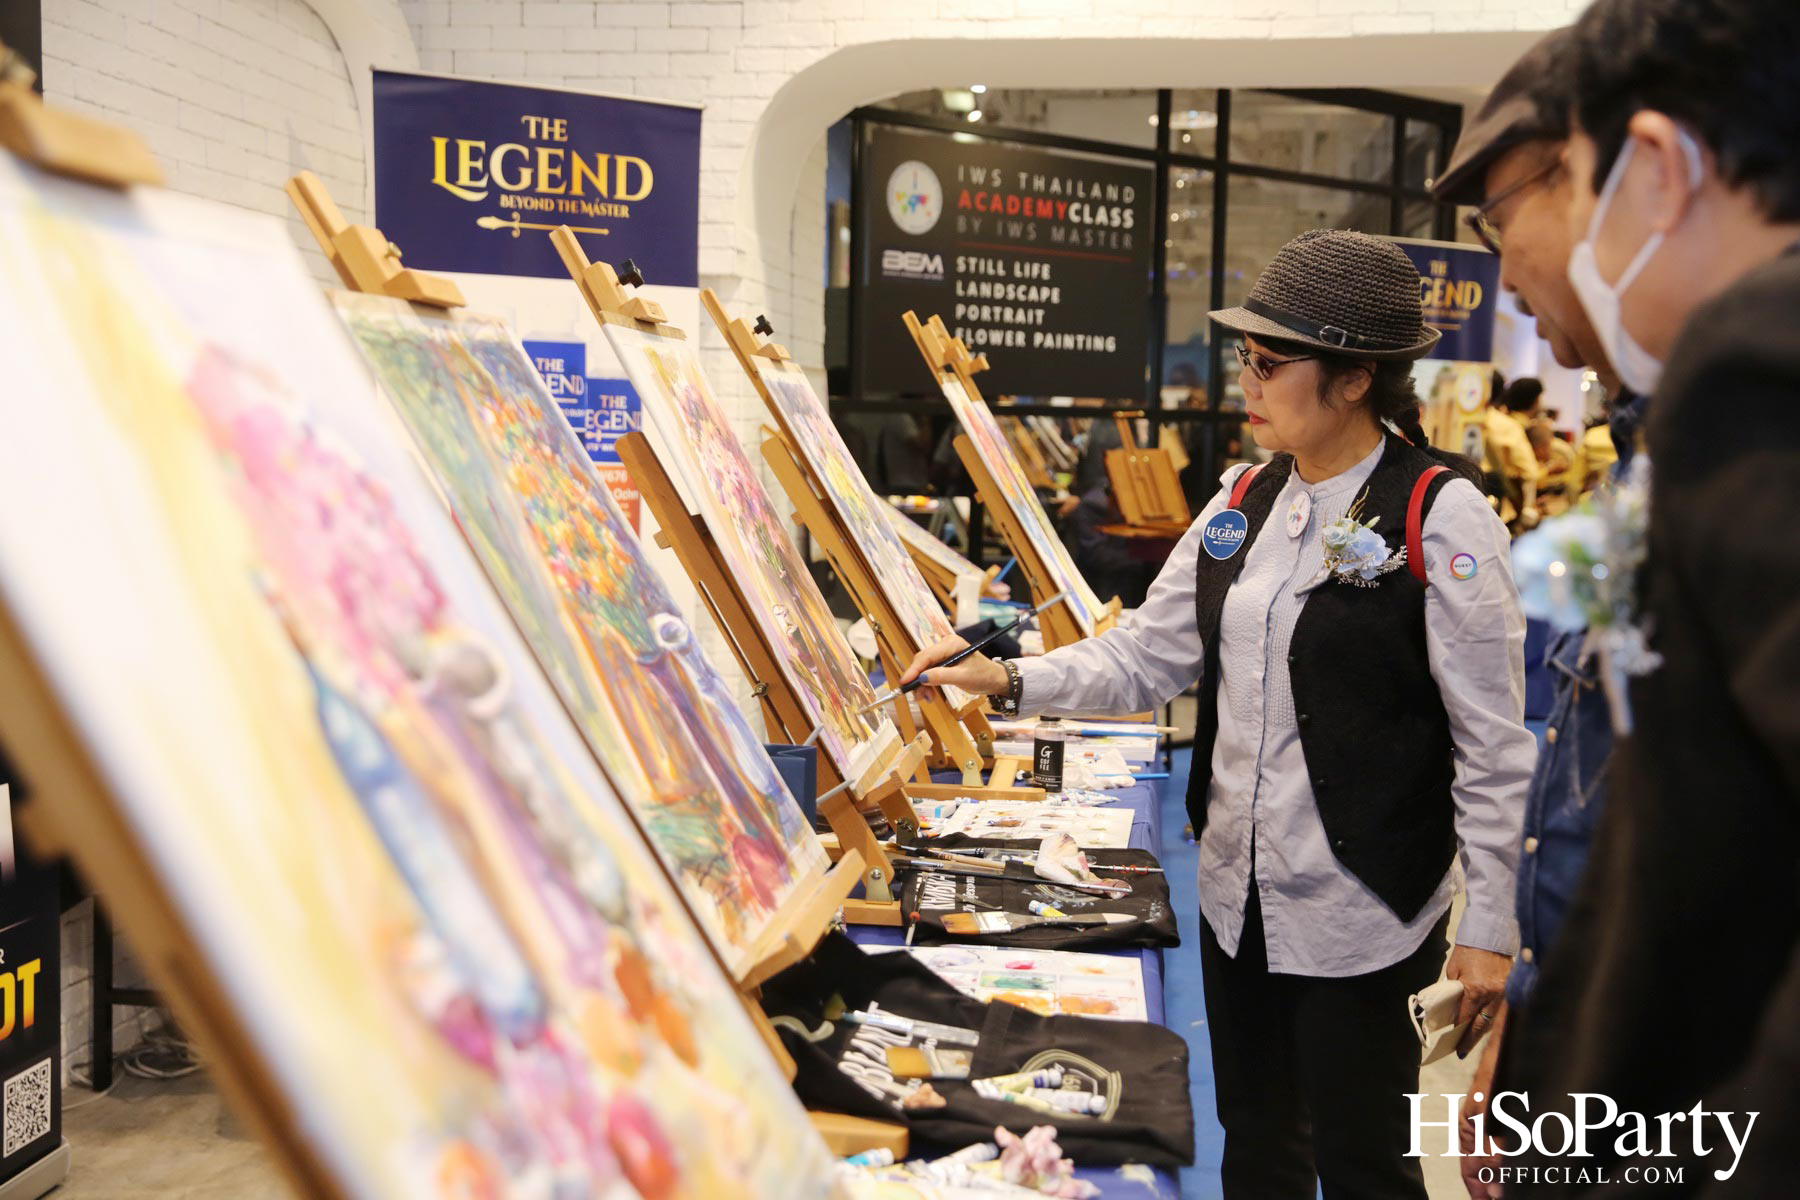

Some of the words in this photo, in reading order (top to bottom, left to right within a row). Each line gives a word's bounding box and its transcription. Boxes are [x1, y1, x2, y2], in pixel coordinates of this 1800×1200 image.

[521, 115, 568, 142] THE
[431, 136, 654, 202] LEGEND
[957, 164, 1002, 188] IWS
[1018, 171, 1136, 204] THAILAND
[500, 193, 555, 211] BEYOND
[557, 199, 579, 213] THE
[957, 214, 982, 234] BY
[998, 220, 1037, 242] IWS
[1051, 225, 1133, 250] MASTER
[956, 255, 1006, 277] STILL
[1013, 260, 1051, 281] LIFE
[955, 279, 1061, 305] LANDSCAPE
[1420, 276, 1482, 310] GEND
[955, 303, 1046, 326] PORTRAIT
[955, 326, 1026, 348] FLOWER
[1032, 331, 1117, 353] PAINTING
[536, 357, 565, 373] THE
[600, 394, 628, 410] THE
[1206, 526, 1245, 539] LEGEND
